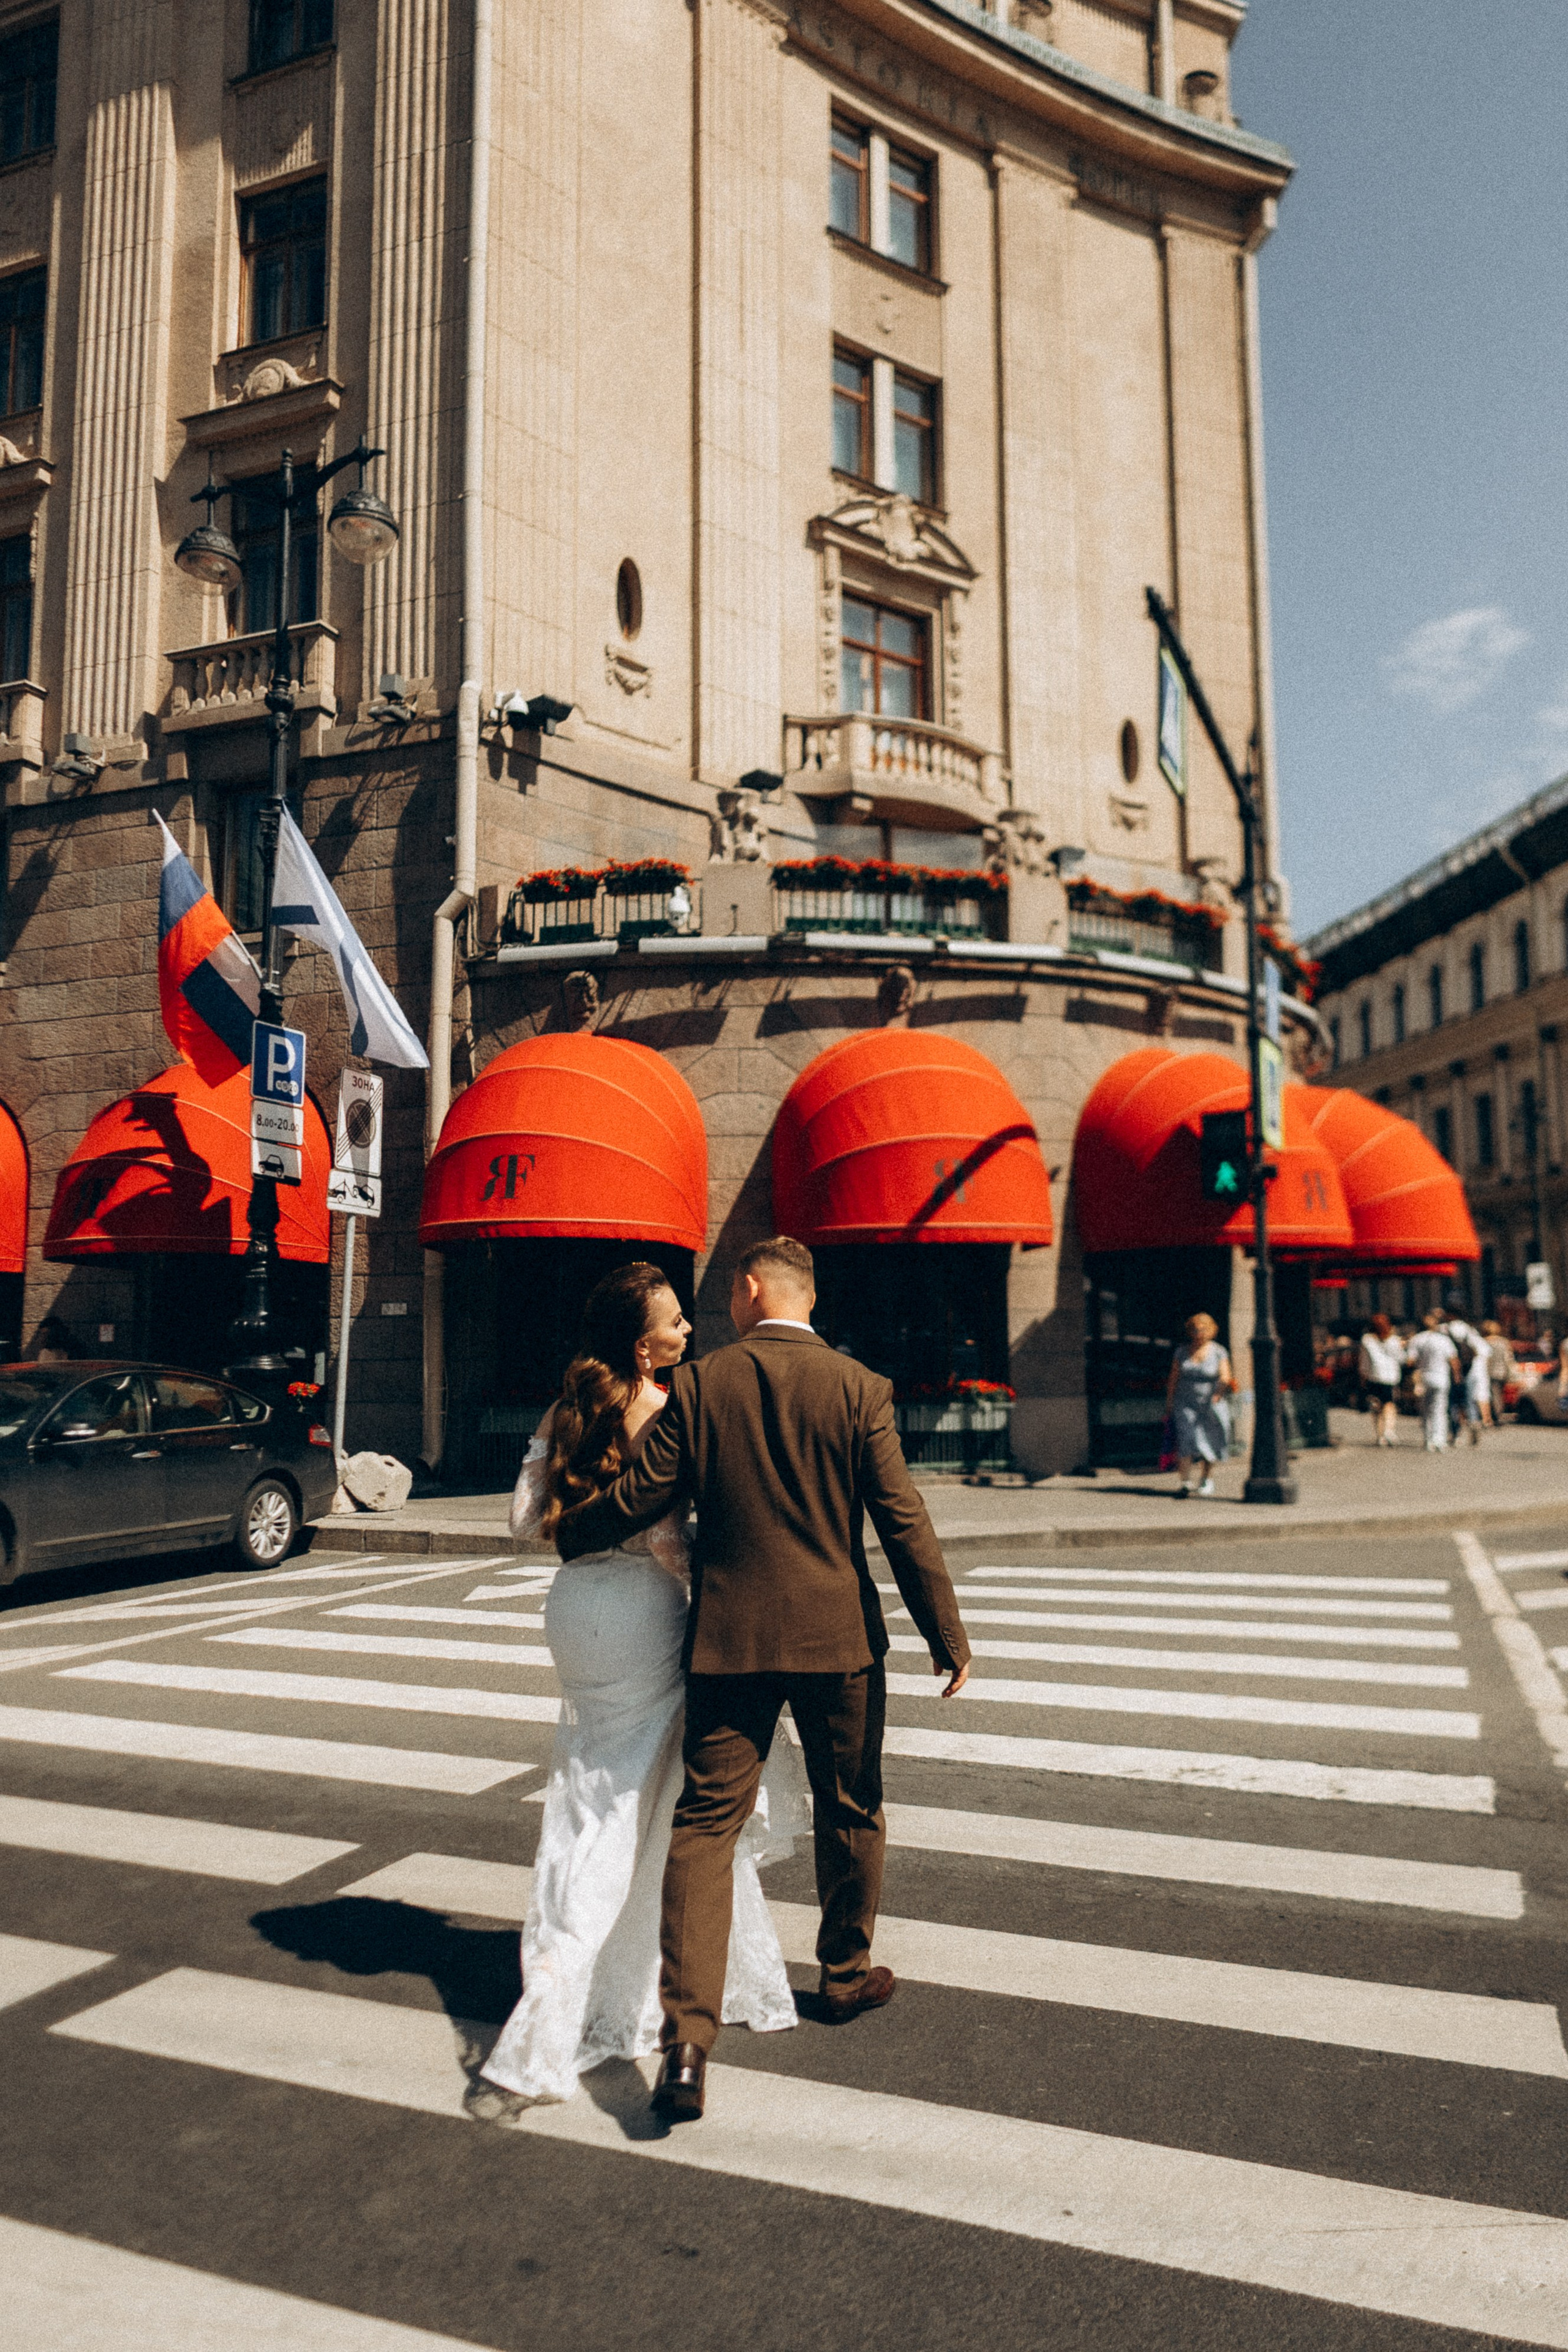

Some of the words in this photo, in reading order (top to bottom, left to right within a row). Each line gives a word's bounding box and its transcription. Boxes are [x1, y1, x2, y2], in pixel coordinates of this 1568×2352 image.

[267, 1033, 296, 1091] P
[352, 1076, 374, 1091] ЗОНА
[256, 1114, 299, 1133] 8.00-20.00
